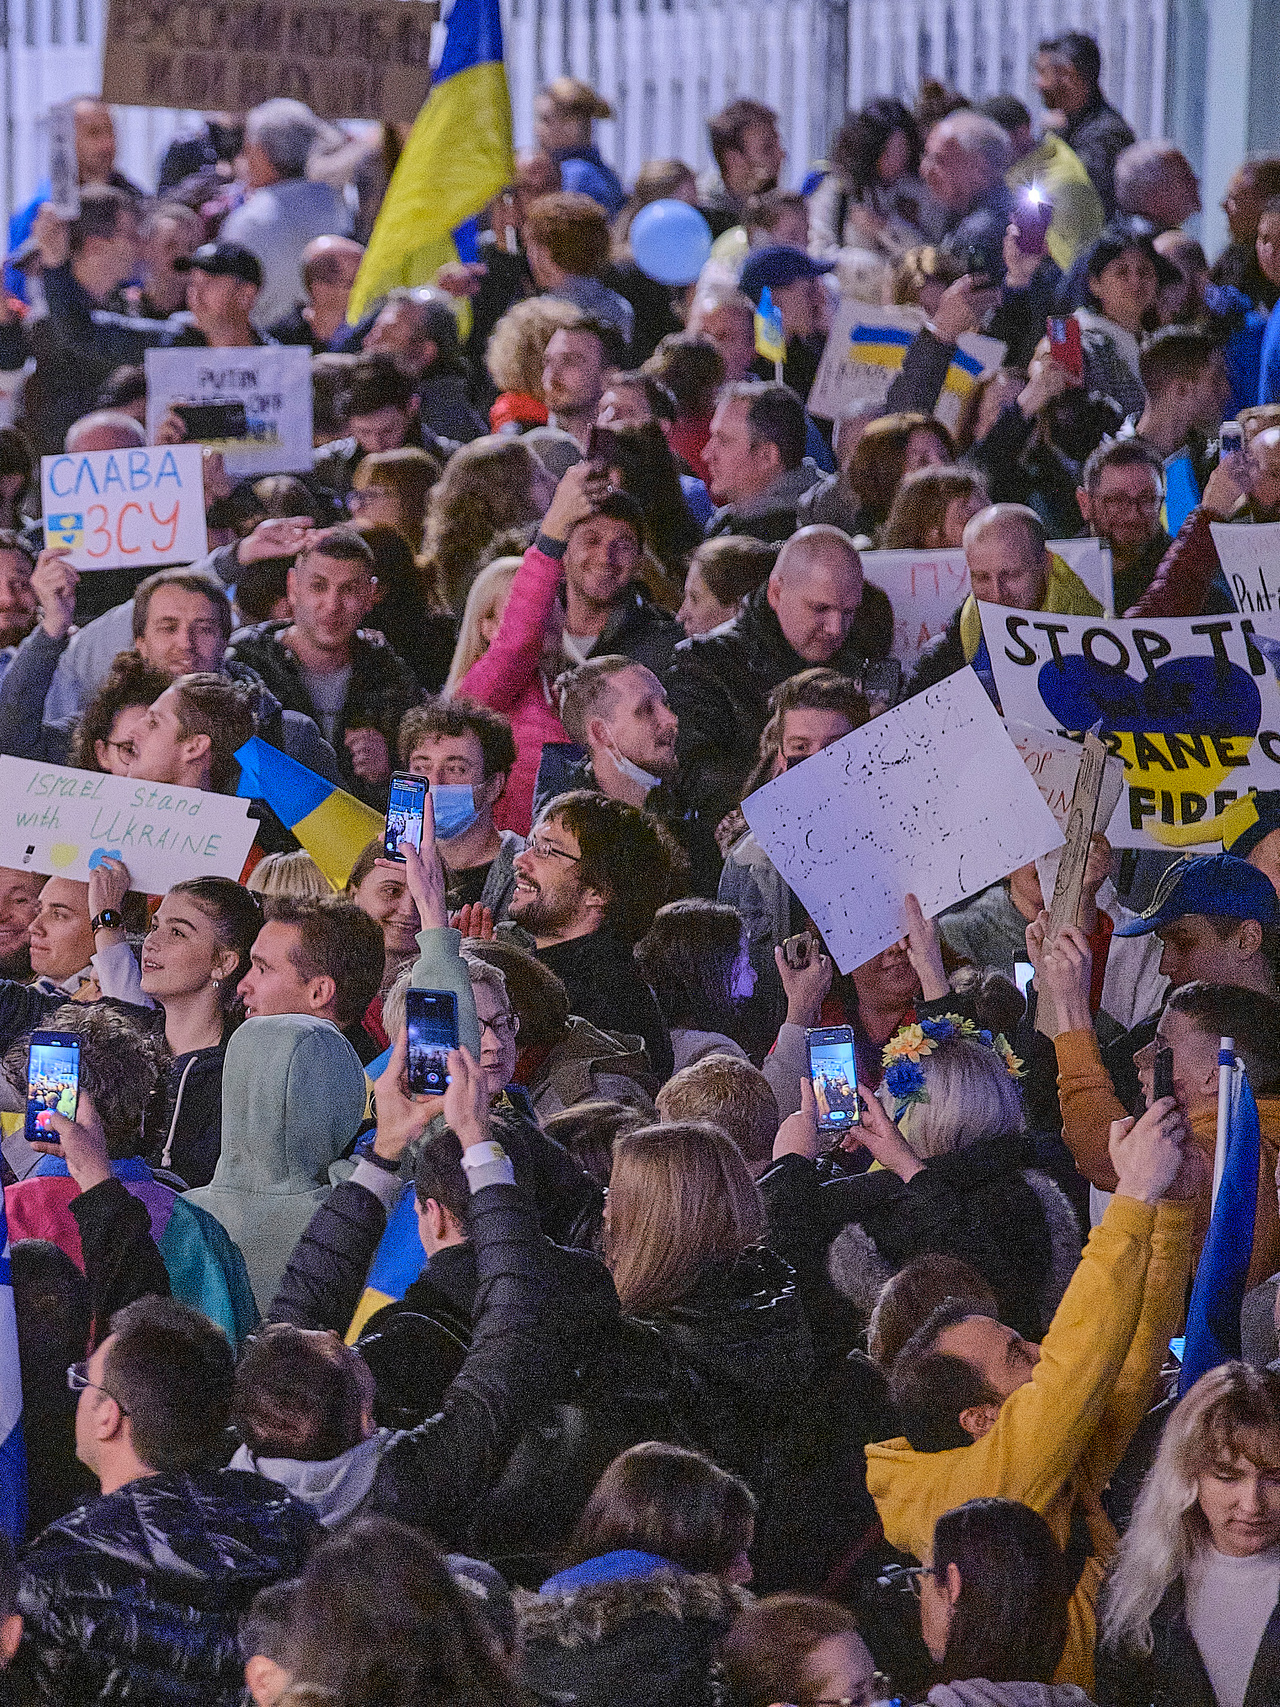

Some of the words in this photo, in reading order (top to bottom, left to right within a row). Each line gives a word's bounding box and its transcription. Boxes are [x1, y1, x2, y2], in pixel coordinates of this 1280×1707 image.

[49, 451, 183, 498] СЛАВА
[87, 500, 180, 558] ЗСУ
[1004, 615, 1172, 679] STOP
[16, 806, 62, 829] with
